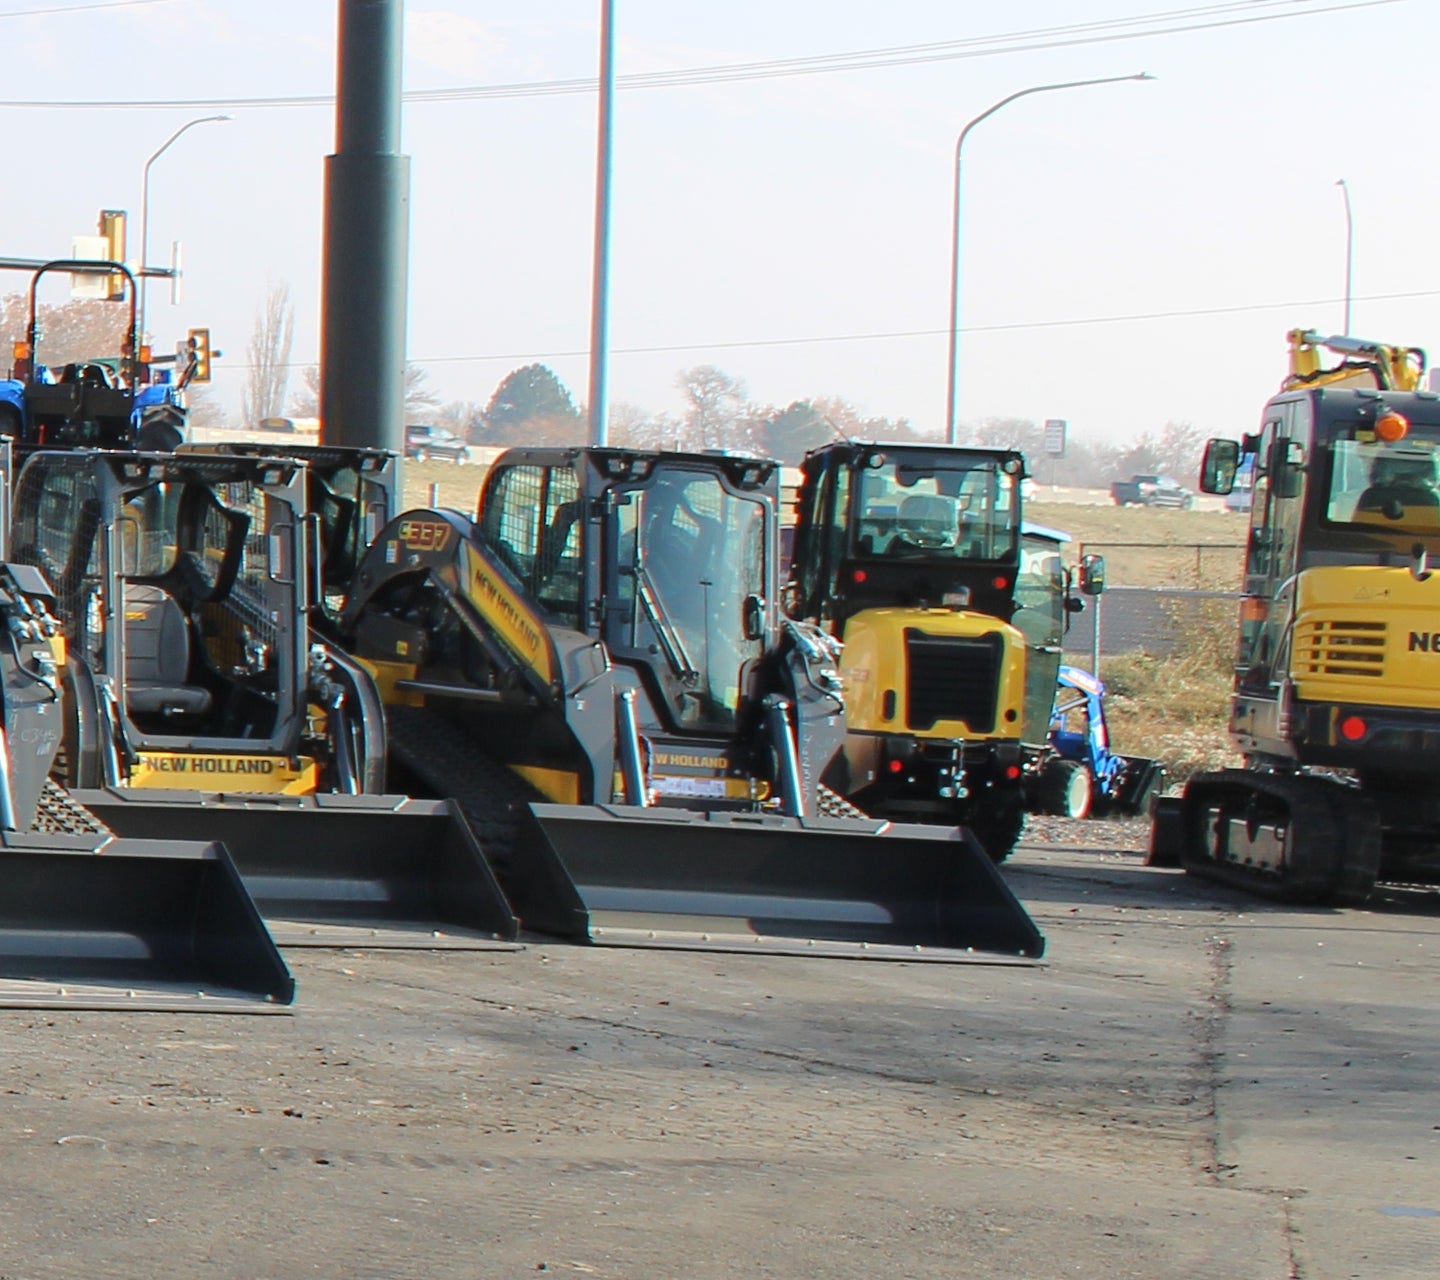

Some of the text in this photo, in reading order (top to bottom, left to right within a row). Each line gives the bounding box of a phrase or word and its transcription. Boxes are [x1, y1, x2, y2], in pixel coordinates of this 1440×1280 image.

[146, 757, 274, 774] NEW HOLLAND
[669, 754, 729, 769] HOLLAND
